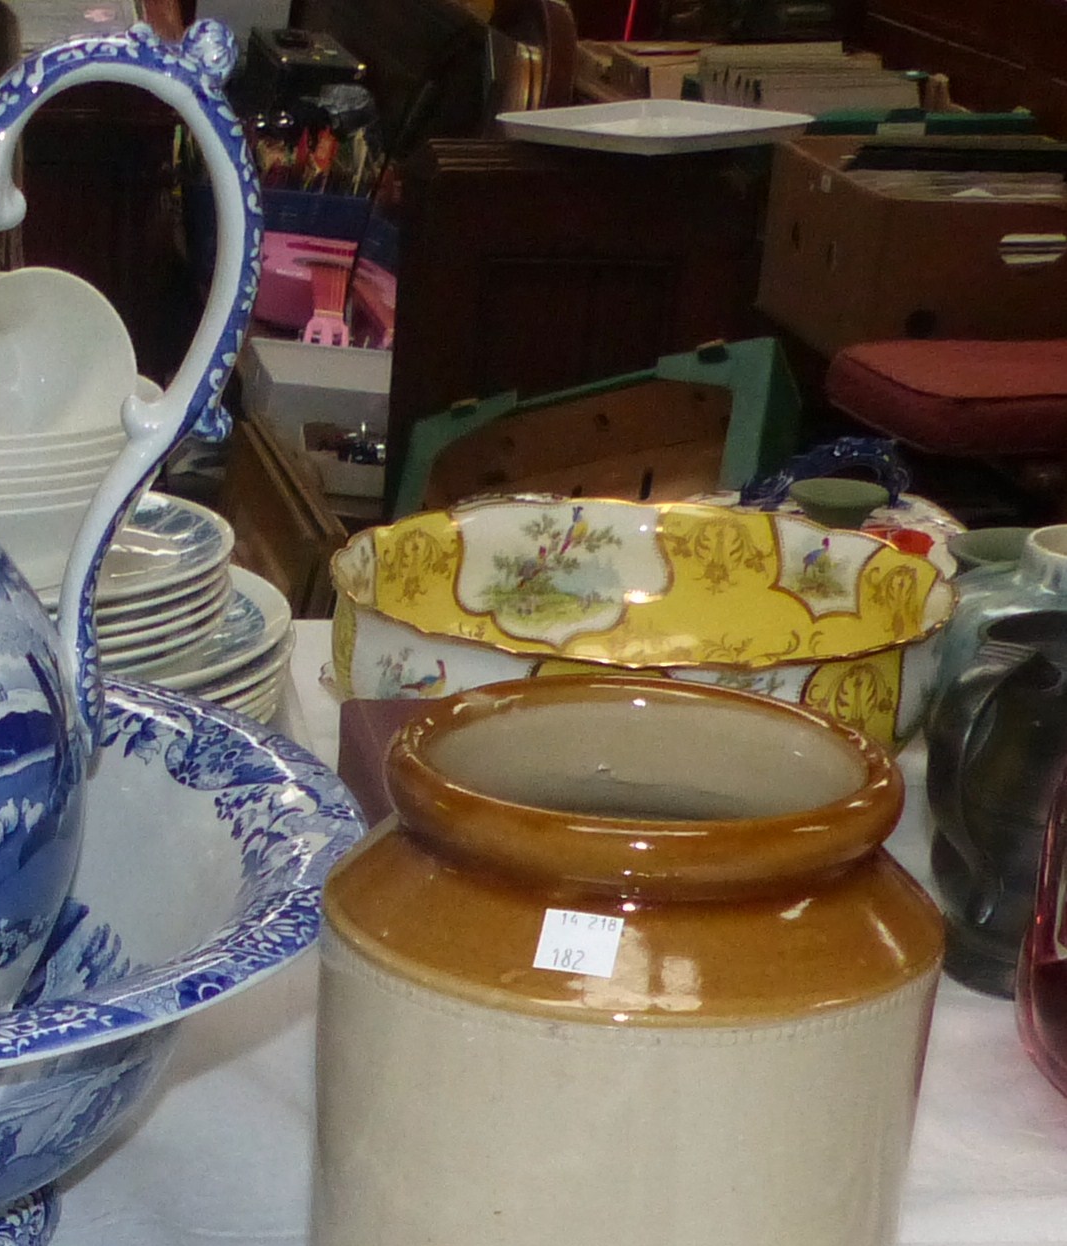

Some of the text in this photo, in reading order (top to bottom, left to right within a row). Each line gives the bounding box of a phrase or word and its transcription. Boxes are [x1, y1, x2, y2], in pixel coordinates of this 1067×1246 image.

[562, 912, 617, 932] 14 218
[553, 947, 585, 971] 182
